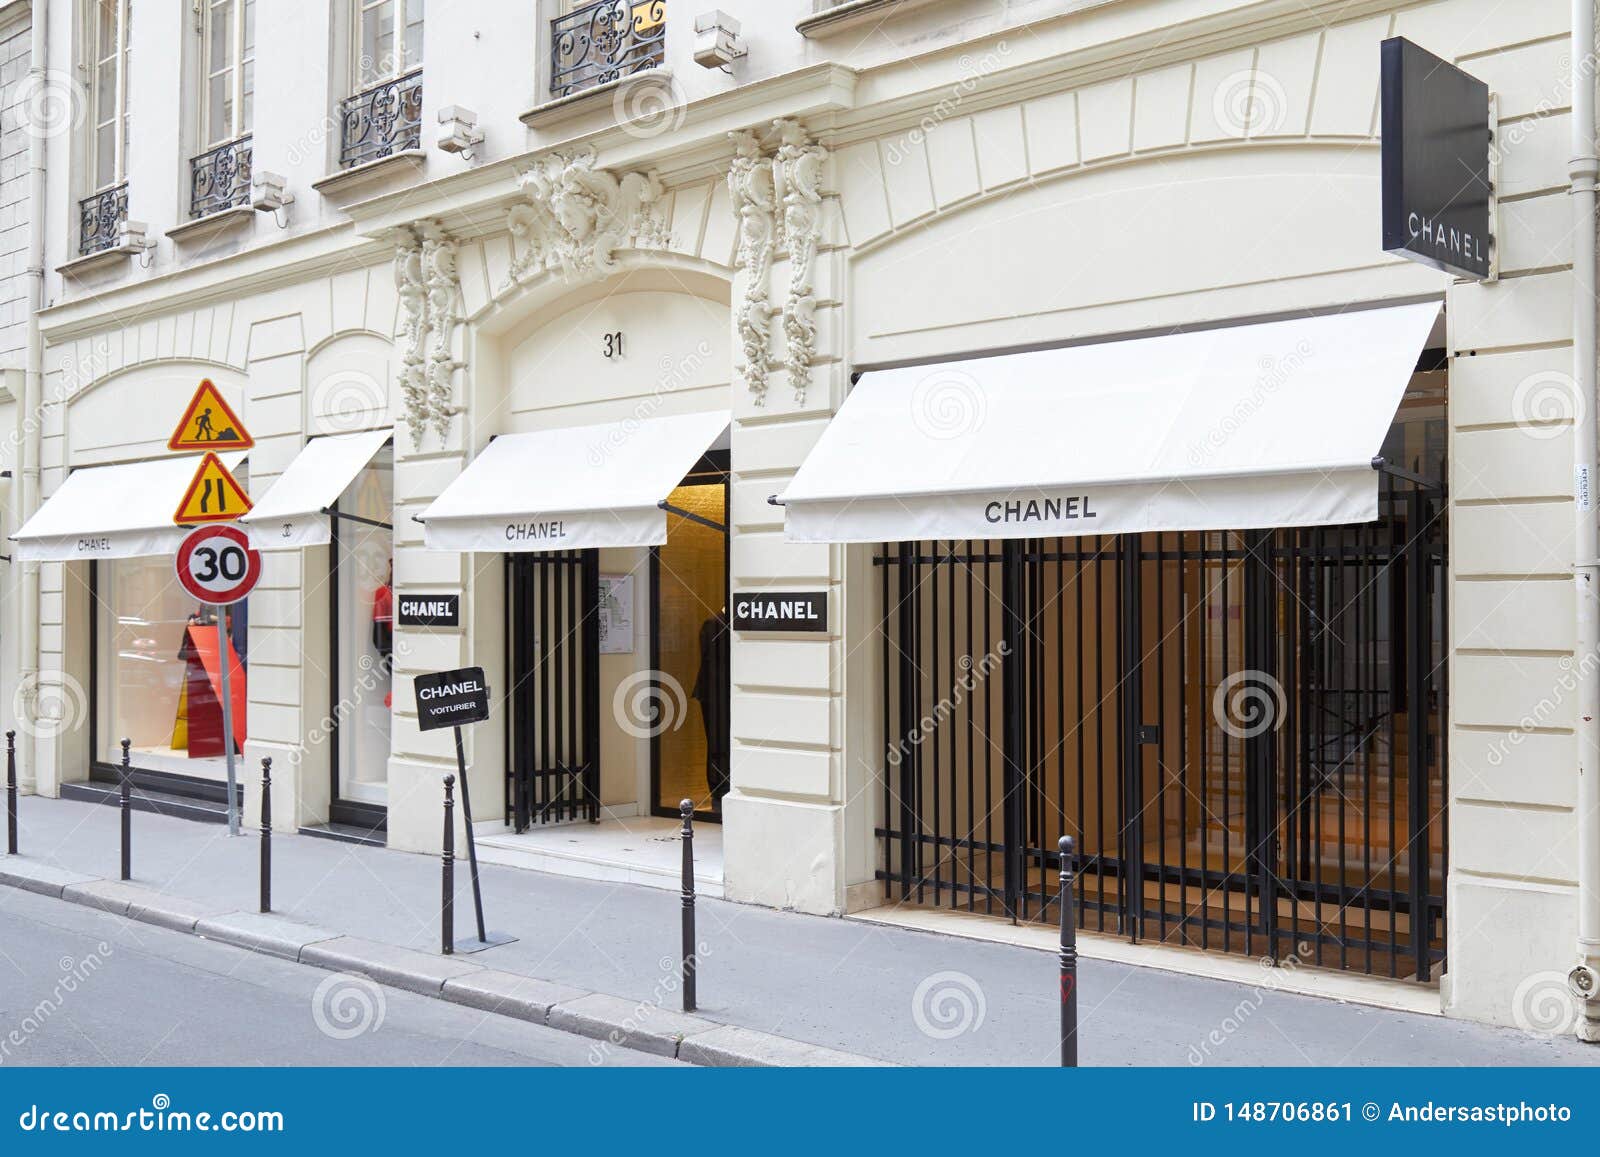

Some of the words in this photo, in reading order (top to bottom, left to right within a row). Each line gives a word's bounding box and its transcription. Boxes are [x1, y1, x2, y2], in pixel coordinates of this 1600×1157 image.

[1408, 212, 1483, 262] CHANEL
[603, 331, 622, 358] 31
[984, 495, 1097, 523] CHANEL
[505, 521, 566, 541] CHANEL
[78, 538, 111, 551] CHANEL
[194, 546, 247, 582] 30
[401, 601, 453, 617] CHANEL
[737, 601, 818, 619] CHANEL
[420, 680, 483, 700] CHANEL
[430, 701, 477, 716] VOITURIER
